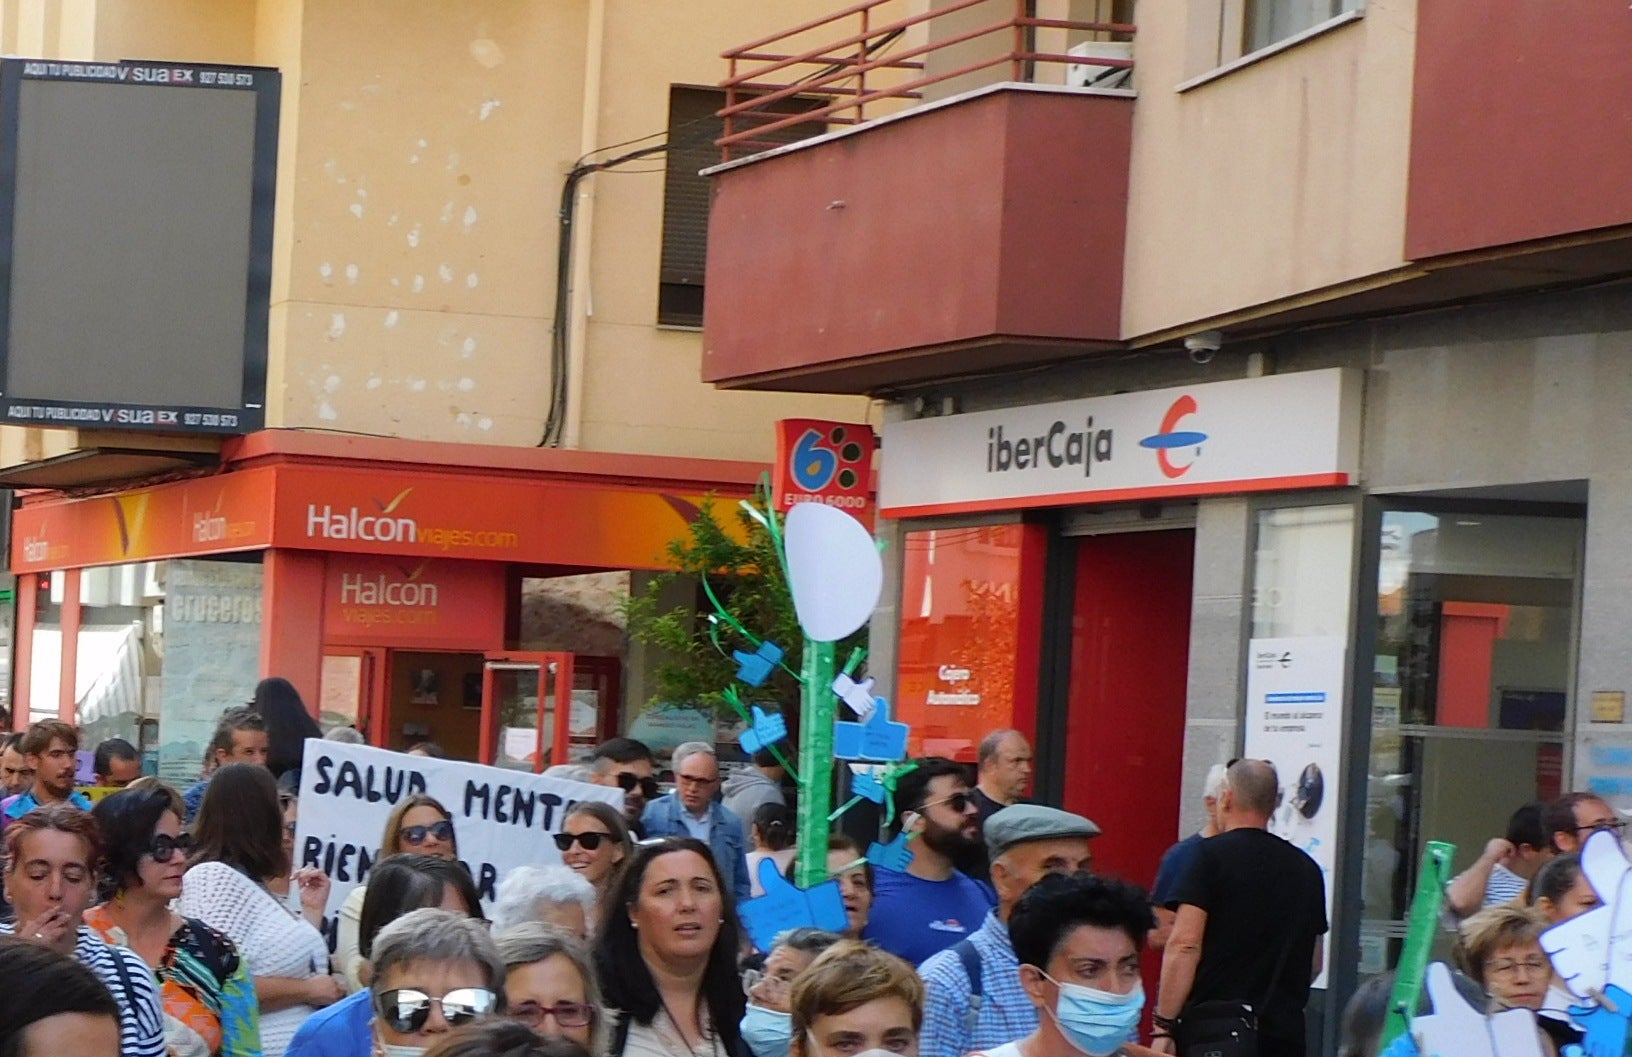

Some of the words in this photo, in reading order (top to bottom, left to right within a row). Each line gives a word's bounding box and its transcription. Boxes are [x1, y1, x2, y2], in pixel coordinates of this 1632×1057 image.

[987, 415, 1113, 478] iberCaja
[784, 493, 824, 505] EURO
[825, 495, 866, 508] 6000
[417, 527, 518, 551] viajes.com
[342, 607, 438, 628] viajes.com
[313, 755, 427, 805] SALUD
